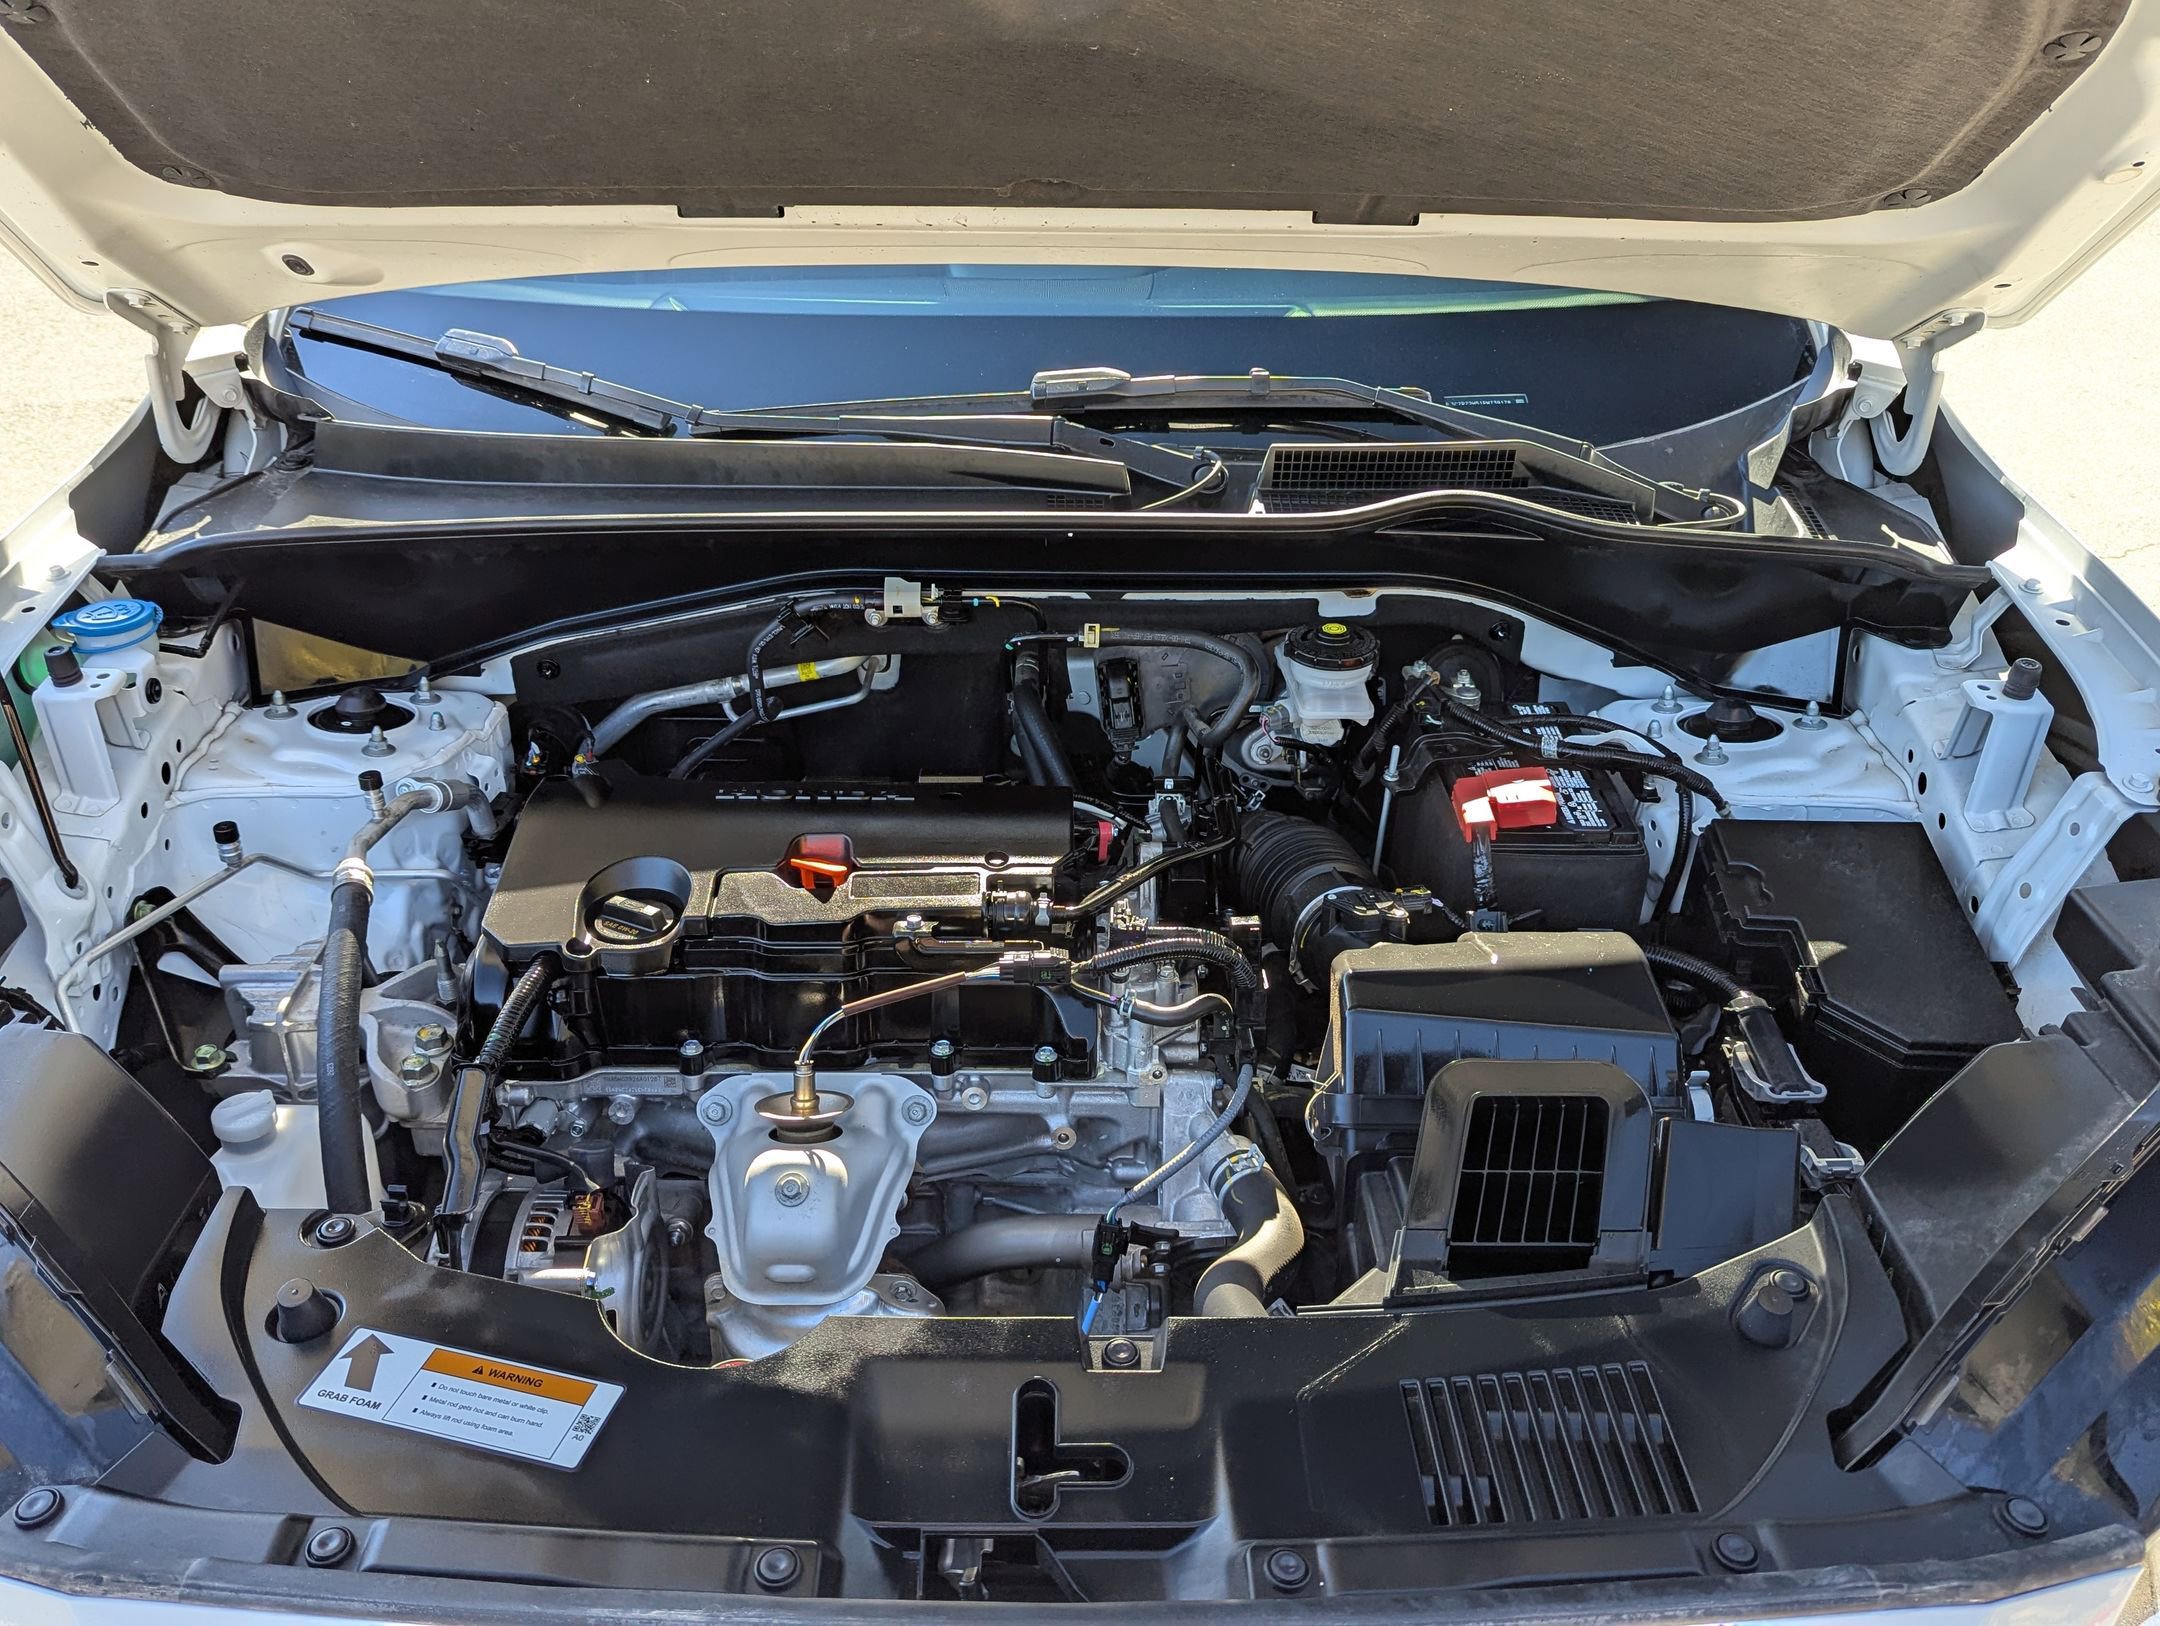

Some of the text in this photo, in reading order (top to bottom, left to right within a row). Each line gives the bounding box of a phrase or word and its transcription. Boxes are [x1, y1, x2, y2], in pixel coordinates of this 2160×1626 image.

[488, 1368, 544, 1388] WARNING
[317, 1389, 382, 1410] GRAB FOAM
[429, 1396, 448, 1405] Metal
[472, 1406, 485, 1414] hot
[438, 1383, 449, 1391] Do
[448, 1386, 460, 1394] not
[459, 1389, 478, 1398] touch
[477, 1393, 493, 1401] bare
[492, 1397, 512, 1406] metal
[519, 1403, 537, 1412] white
[419, 1409, 442, 1420] Always
[441, 1414, 452, 1422] lift
[462, 1420, 481, 1430] using
[480, 1423, 498, 1432] foam
